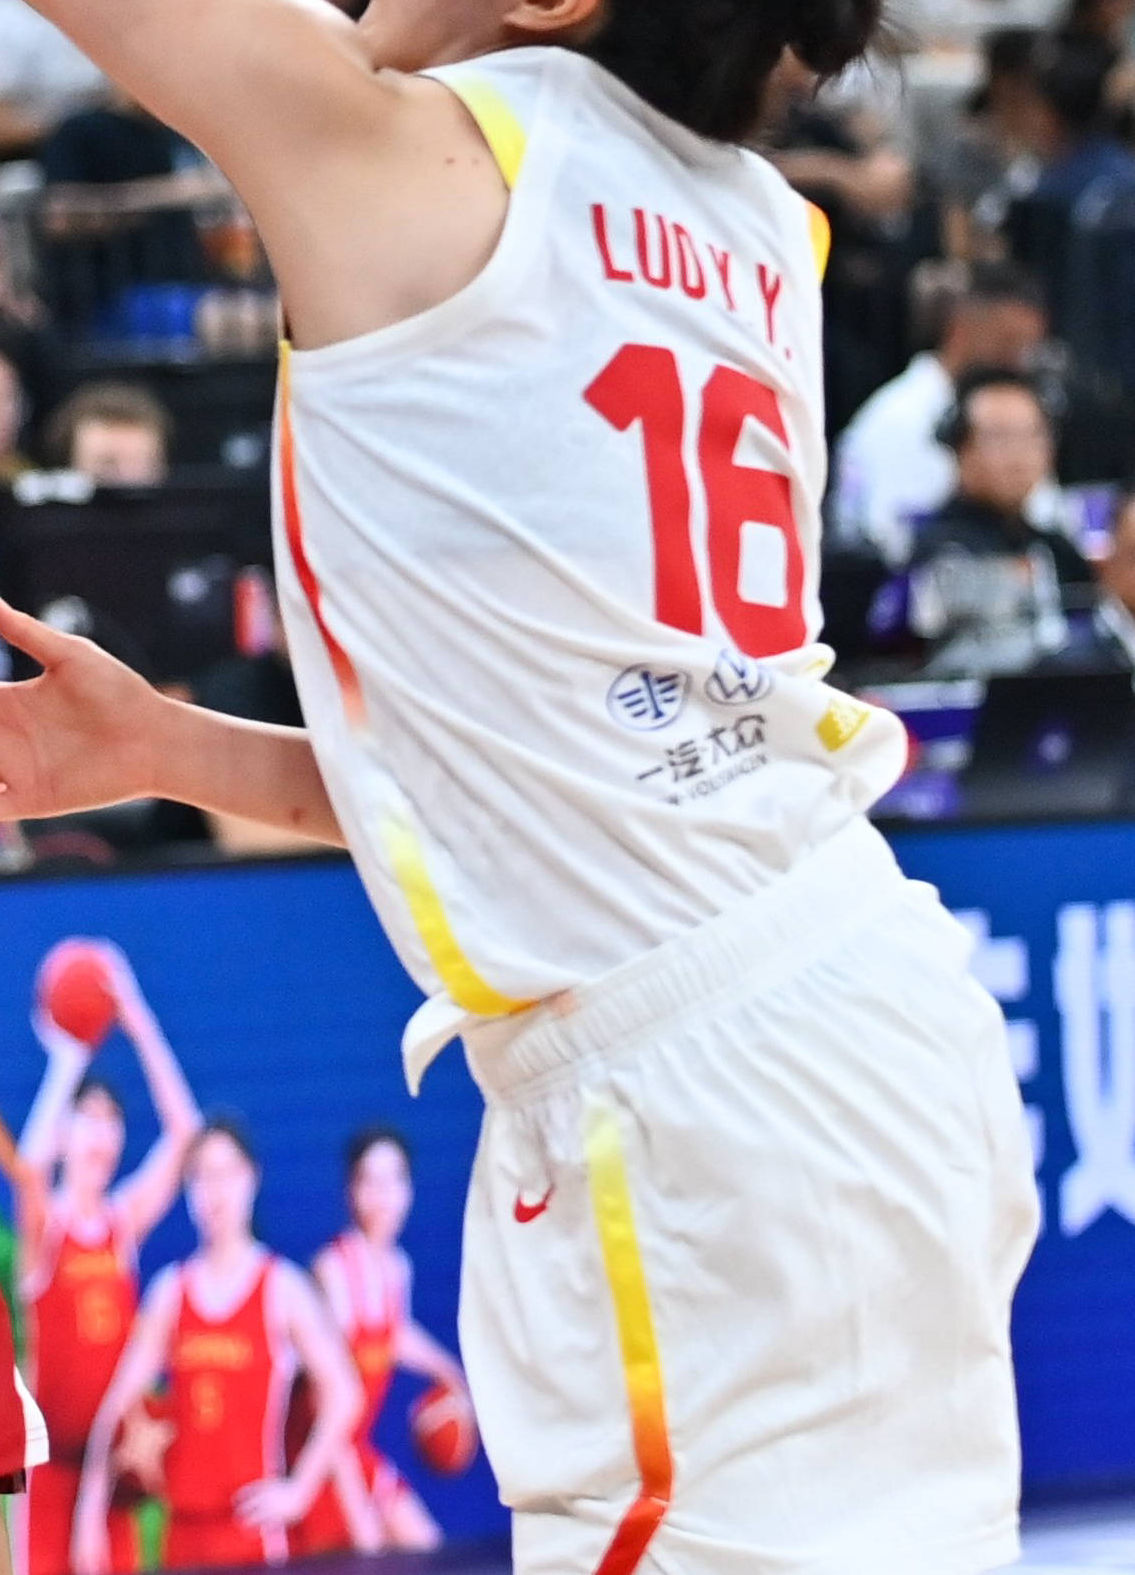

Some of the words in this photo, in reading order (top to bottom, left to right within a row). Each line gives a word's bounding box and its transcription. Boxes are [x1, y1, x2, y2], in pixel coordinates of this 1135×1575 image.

[590, 203, 736, 312] LUDY
[757, 263, 794, 360] Y.
[582, 343, 807, 660] 16
